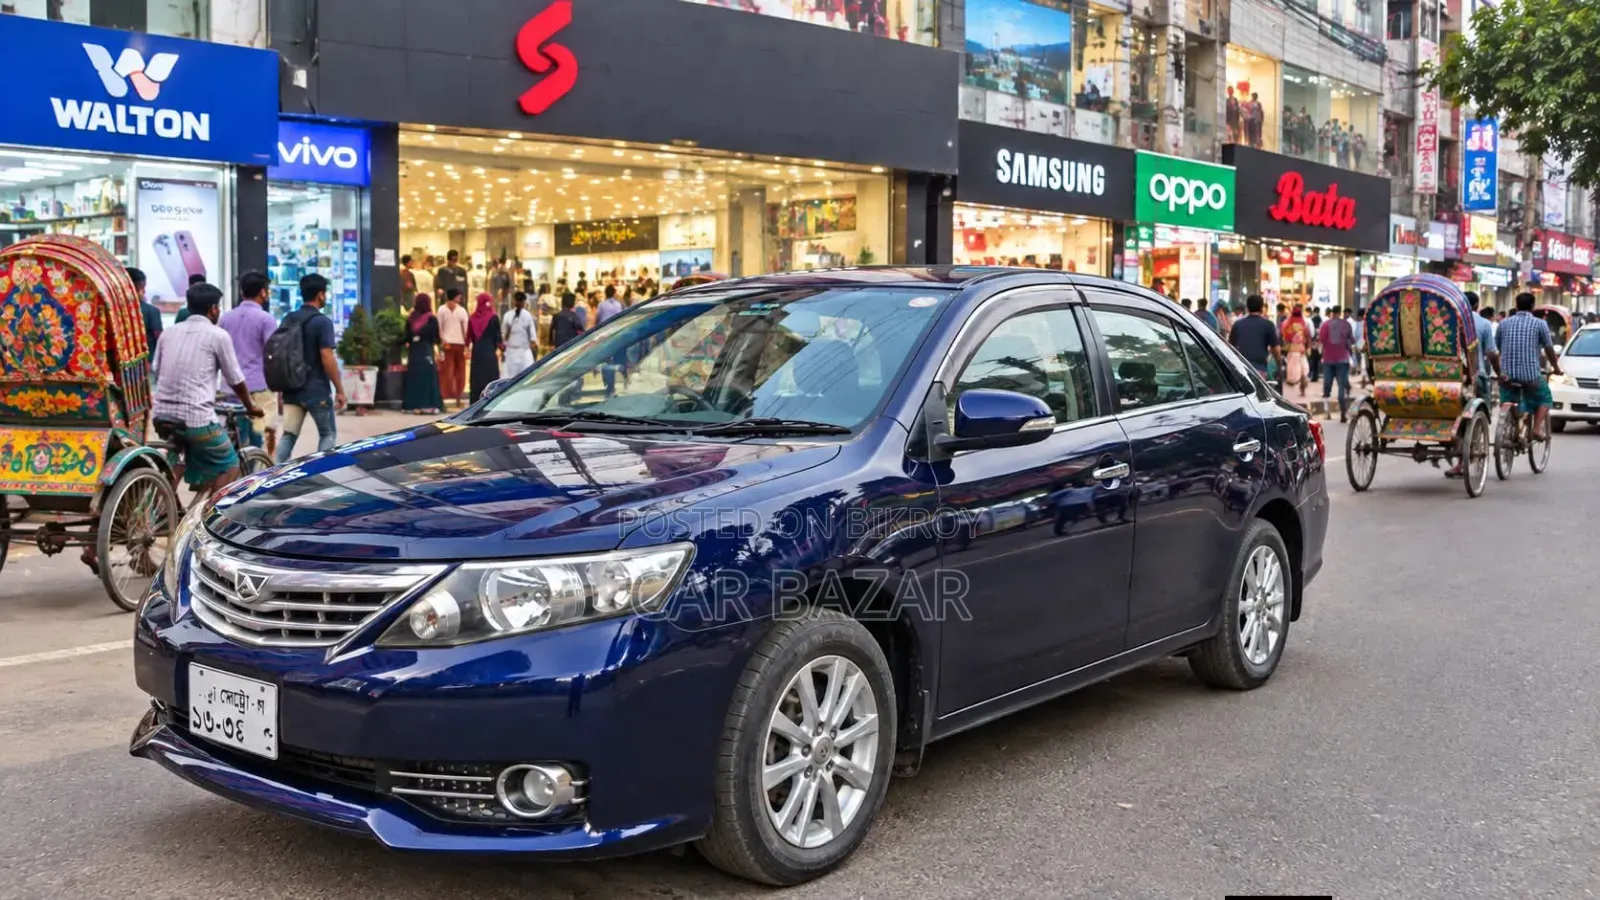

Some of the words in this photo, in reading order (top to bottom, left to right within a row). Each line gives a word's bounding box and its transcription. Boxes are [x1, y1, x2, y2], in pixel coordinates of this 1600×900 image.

[50, 96, 210, 142] WALTON
[277, 136, 358, 169] vivo
[996, 148, 1106, 197] SAMSUNG
[1149, 172, 1227, 215] oppo
[1269, 171, 1357, 231] Bata
